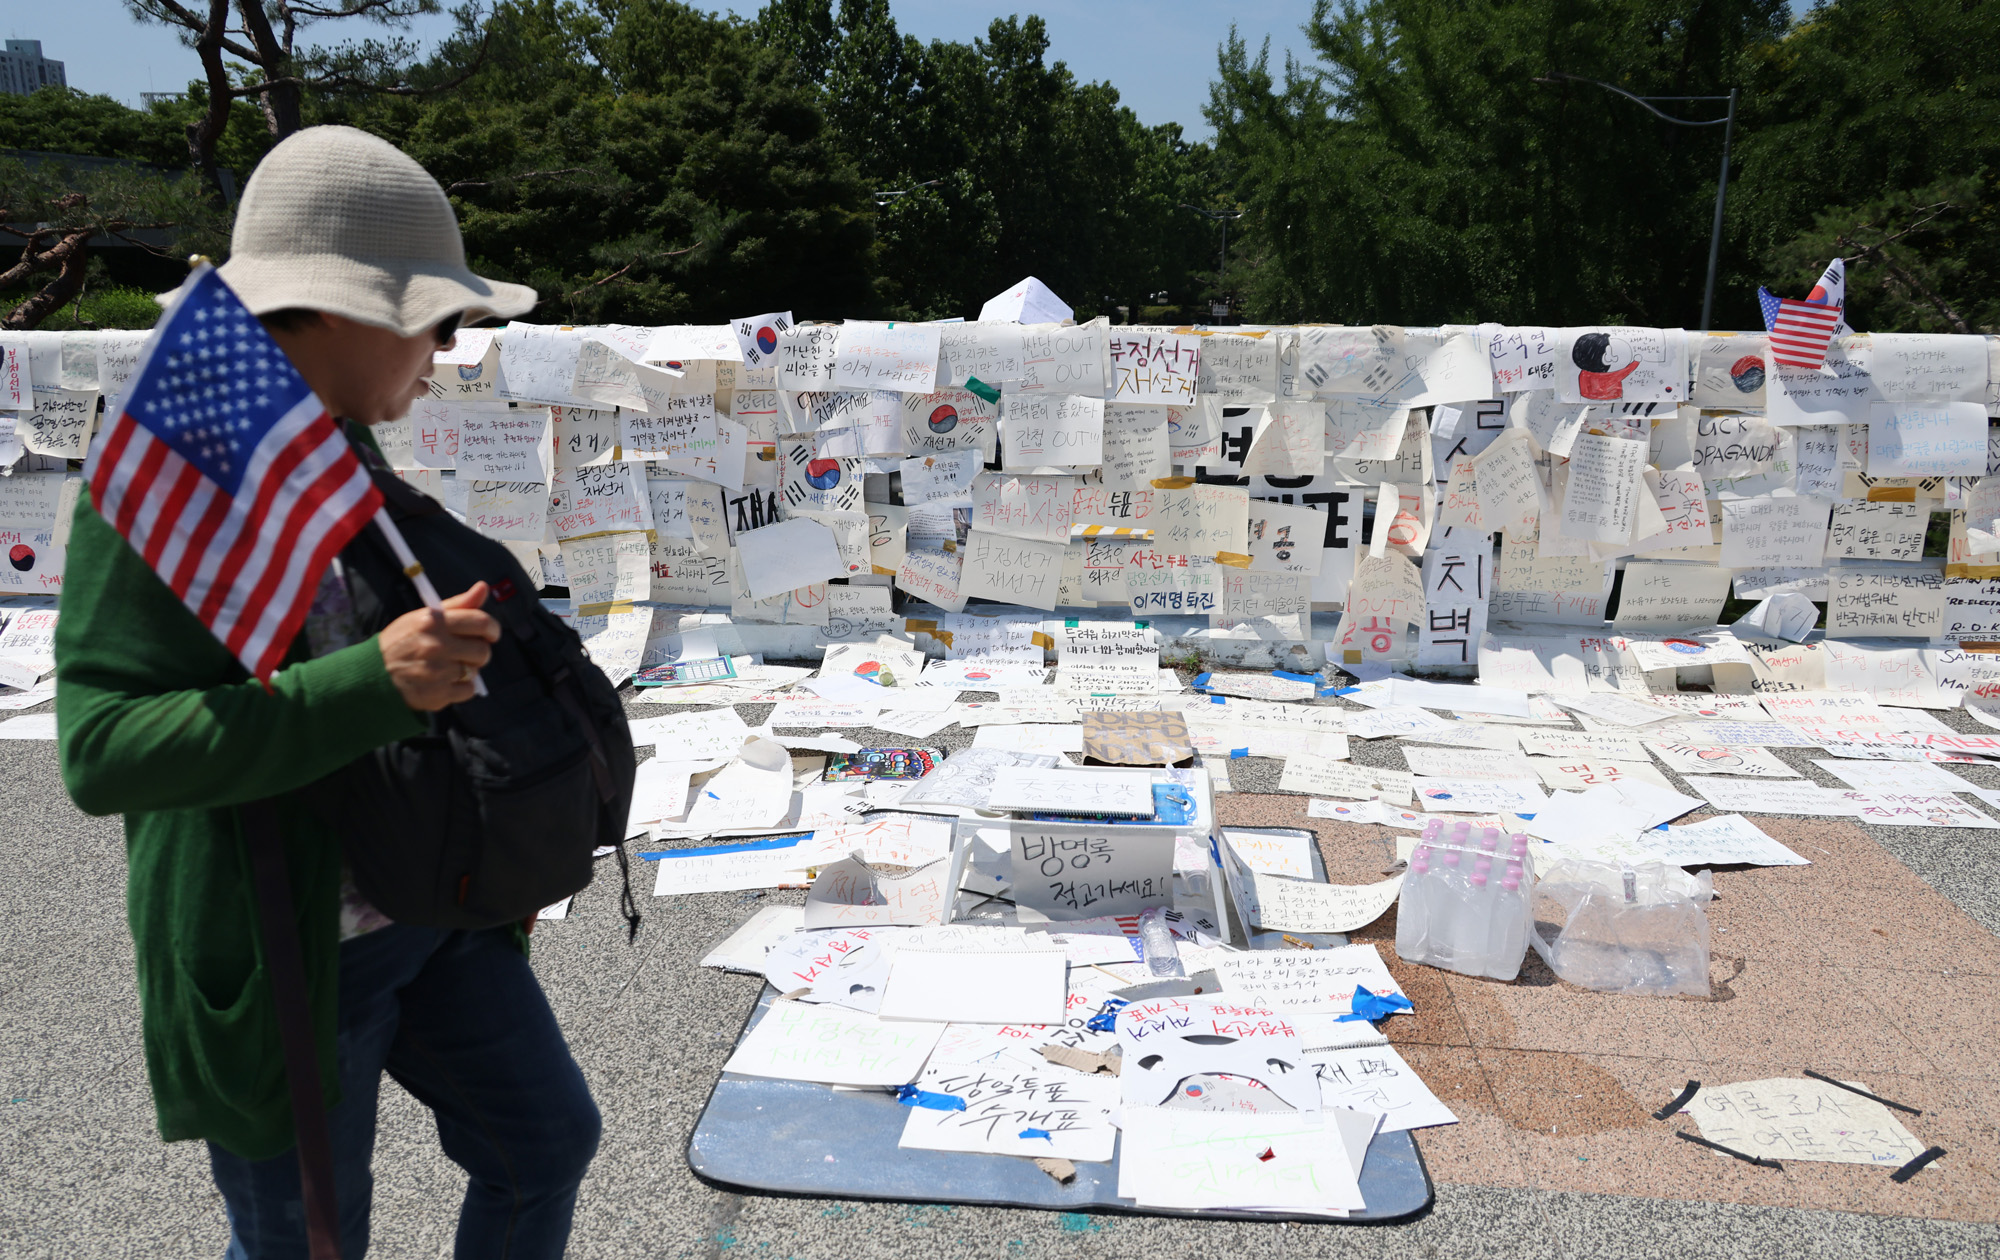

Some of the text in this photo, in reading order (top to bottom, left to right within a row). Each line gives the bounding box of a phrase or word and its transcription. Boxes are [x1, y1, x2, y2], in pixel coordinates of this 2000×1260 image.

[784, 345, 823, 359] 가난한
[966, 346, 1000, 359] 지키는
[1055, 336, 1094, 353] OUT
[1489, 330, 1555, 360] 윤석열
[1110, 338, 1201, 376] 부정선거
[8, 348, 20, 404] 부정선거
[784, 361, 820, 377] 씨앗을
[955, 358, 1020, 378] 마지막 기회
[1055, 363, 1093, 382] OUT
[1115, 367, 1197, 404] 재선거!
[1238, 374, 1262, 383] STEAL
[814, 391, 873, 425] 지켜주세요
[1009, 401, 1098, 421] 윤석열이 옳았다
[630, 418, 653, 430] 자유를
[420, 428, 460, 456] 부정
[630, 427, 697, 446] 기억할 것이다!
[923, 435, 956, 450] 재선거
[1016, 427, 1101, 448] 간첩 OUT!!!
[934, 462, 961, 472] 대한민국
[584, 482, 625, 498] 재선거
[808, 492, 839, 506] 재선거
[973, 537, 1053, 569] 부정선거
[986, 570, 1046, 596] 재선거
[1127, 569, 1213, 587] 당일선거 수개표
[1249, 575, 1299, 593] 민주주의
[1643, 575, 1672, 589] 나는
[1133, 591, 1216, 609] 이재명 퇴진
[1835, 592, 1899, 608] 선거법위반
[1902, 608, 1941, 627] 반대!
[1065, 628, 1099, 644] 두려워
[1066, 645, 1115, 655] 내가 너와
[1020, 834, 1115, 878] 방명록
[1050, 876, 1165, 910] 적고가세요!
[1126, 1015, 1196, 1042] 재선거
[1212, 1019, 1296, 1038] 부정선거
